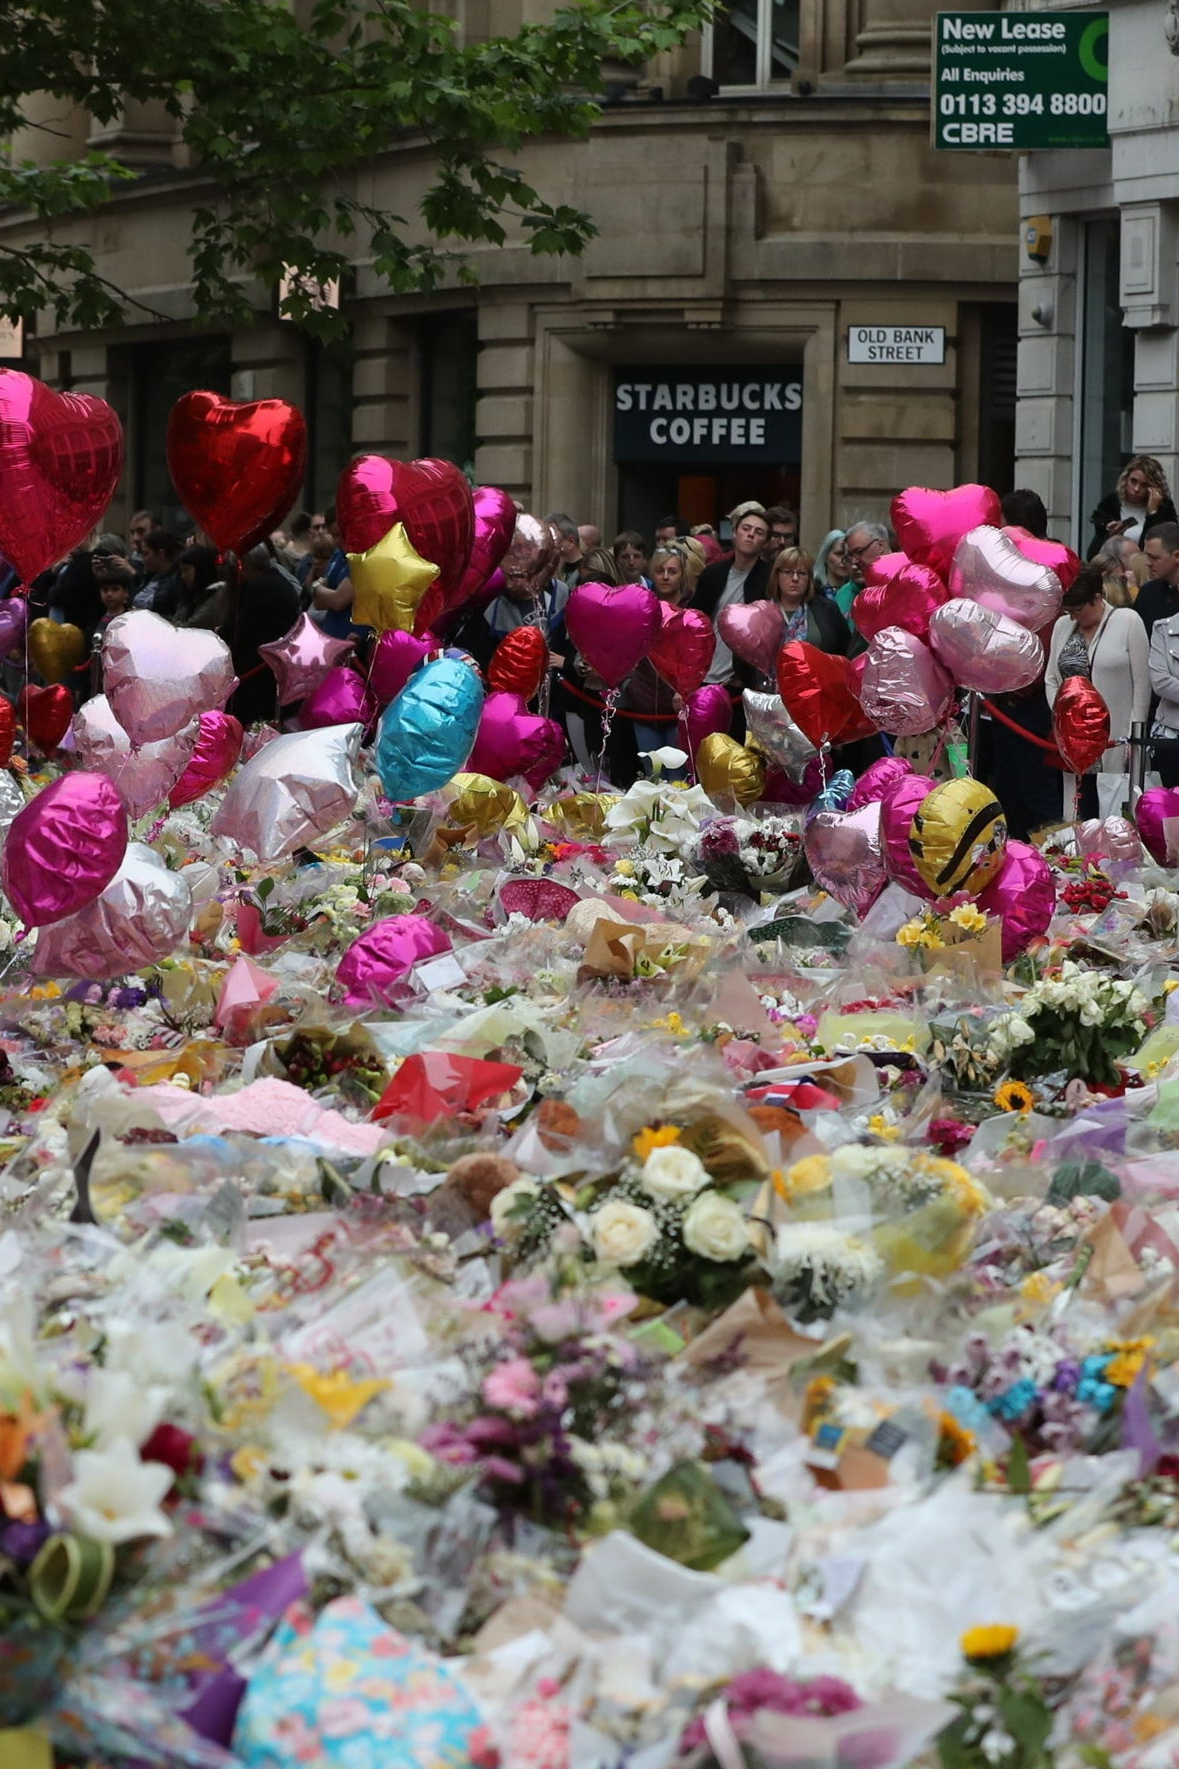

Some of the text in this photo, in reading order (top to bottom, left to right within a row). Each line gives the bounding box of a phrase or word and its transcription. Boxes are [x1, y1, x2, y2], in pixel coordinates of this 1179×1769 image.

[943, 18, 1066, 39] New Lease
[941, 44, 1067, 55] (Subject to vacant possession)
[941, 68, 1025, 84] All Enquiries
[940, 93, 1106, 116] 0113 394 8800
[942, 122, 1014, 144] CBRE
[857, 329, 935, 345] OLD BANK
[867, 346, 924, 361] STREET
[616, 382, 803, 411] STARBUCKS
[649, 417, 766, 446] COFFEE
